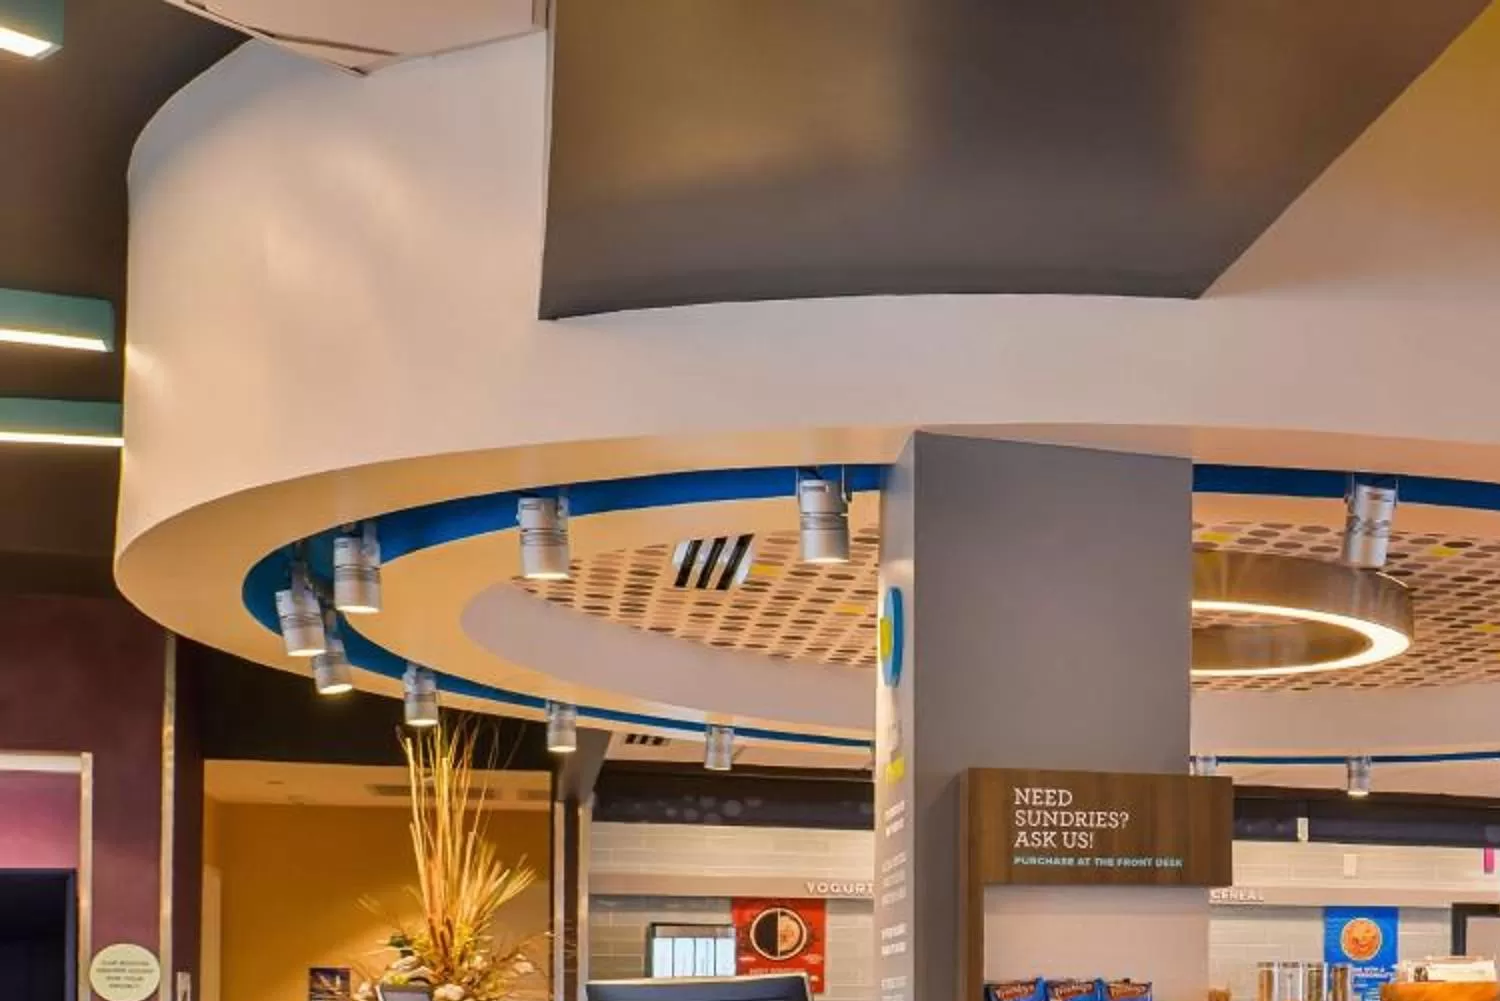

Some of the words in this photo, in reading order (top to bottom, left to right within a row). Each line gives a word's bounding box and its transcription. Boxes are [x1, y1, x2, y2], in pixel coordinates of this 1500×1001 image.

[1014, 787, 1073, 807] NEED
[1014, 809, 1129, 830] SUNDRIES?
[1014, 831, 1058, 848] ASK
[1062, 832, 1094, 849] US!
[1013, 856, 1075, 866] PURCHASE
[1077, 857, 1091, 866] AT
[1095, 857, 1115, 867] THE
[1117, 858, 1152, 867] FRONT
[1155, 859, 1183, 868] DESK
[806, 881, 873, 894] YOGURT
